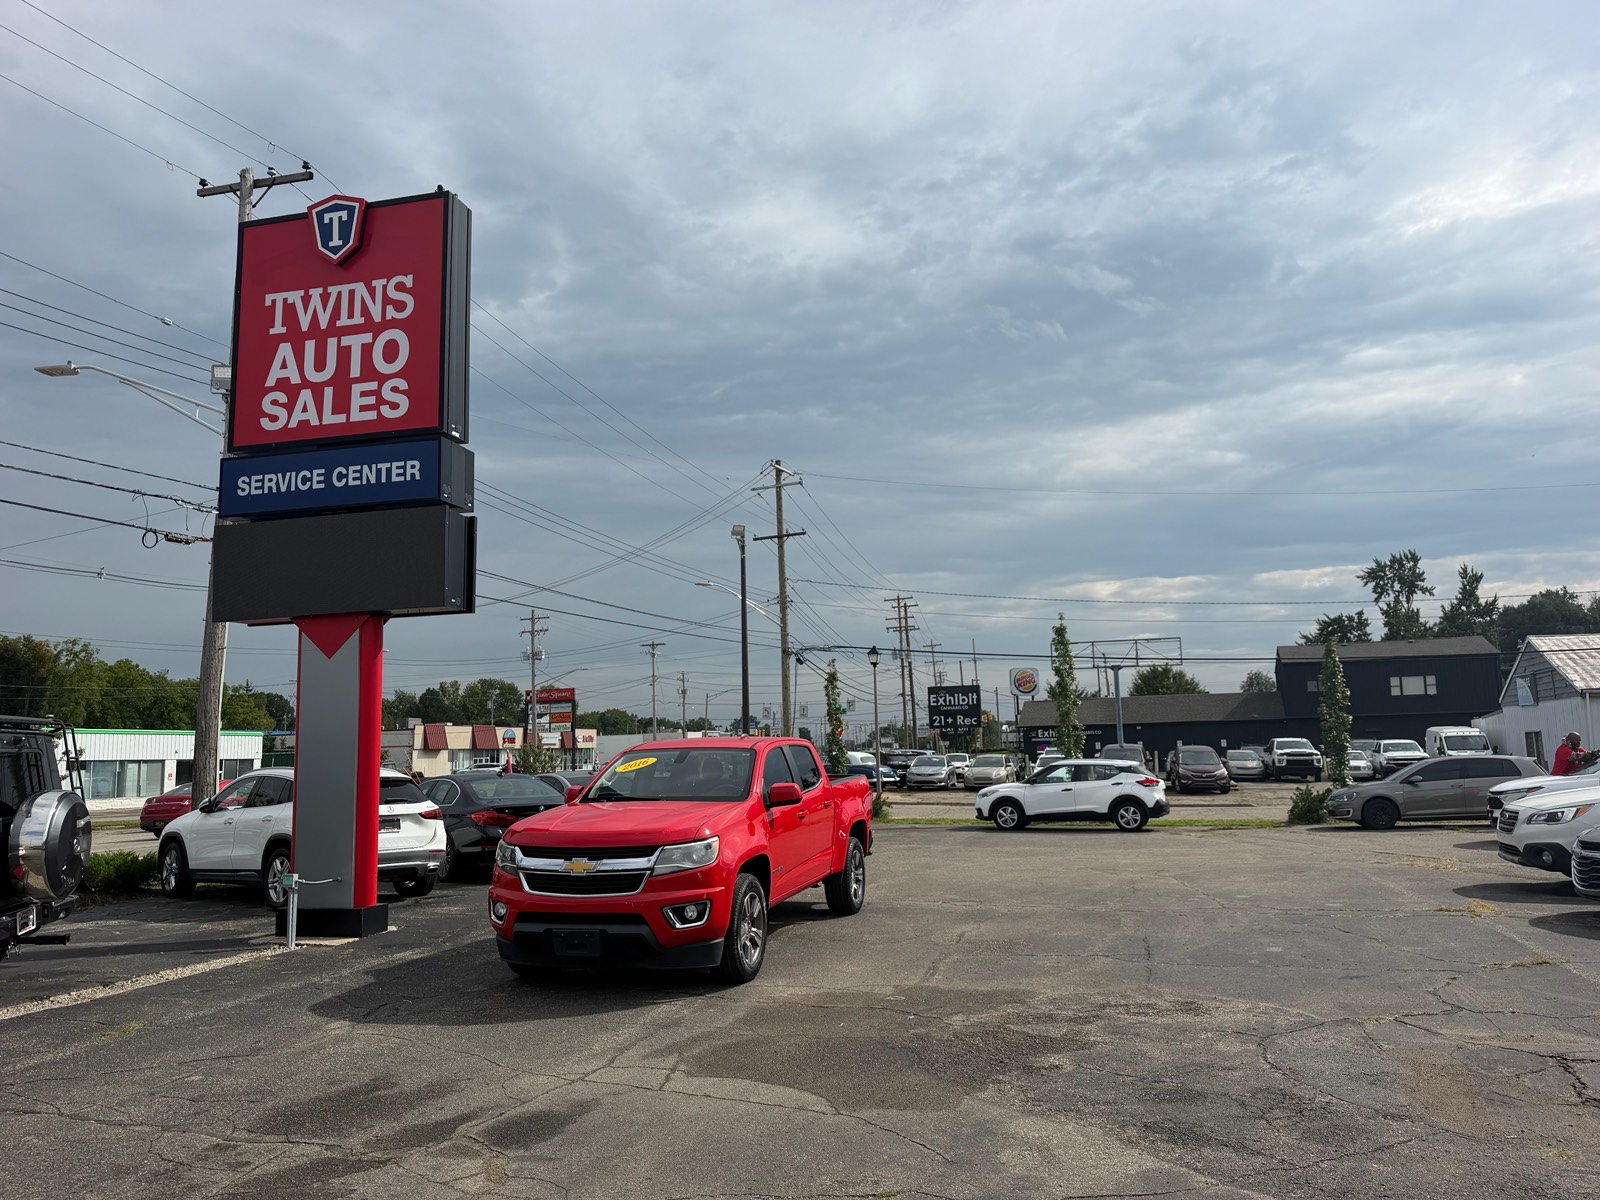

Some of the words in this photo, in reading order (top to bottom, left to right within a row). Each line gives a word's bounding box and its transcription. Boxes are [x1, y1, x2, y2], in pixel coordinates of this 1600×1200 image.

[323, 209, 348, 247] T
[264, 274, 415, 335] TWINS
[264, 328, 410, 388] AUTO
[259, 377, 409, 431] SALES
[236, 468, 325, 497] SERVICE
[332, 459, 421, 488] CENTER
[1017, 677, 1036, 688] KING
[932, 715, 954, 726] 21+
[956, 714, 978, 726] Rec
[622, 759, 649, 771] 2016
